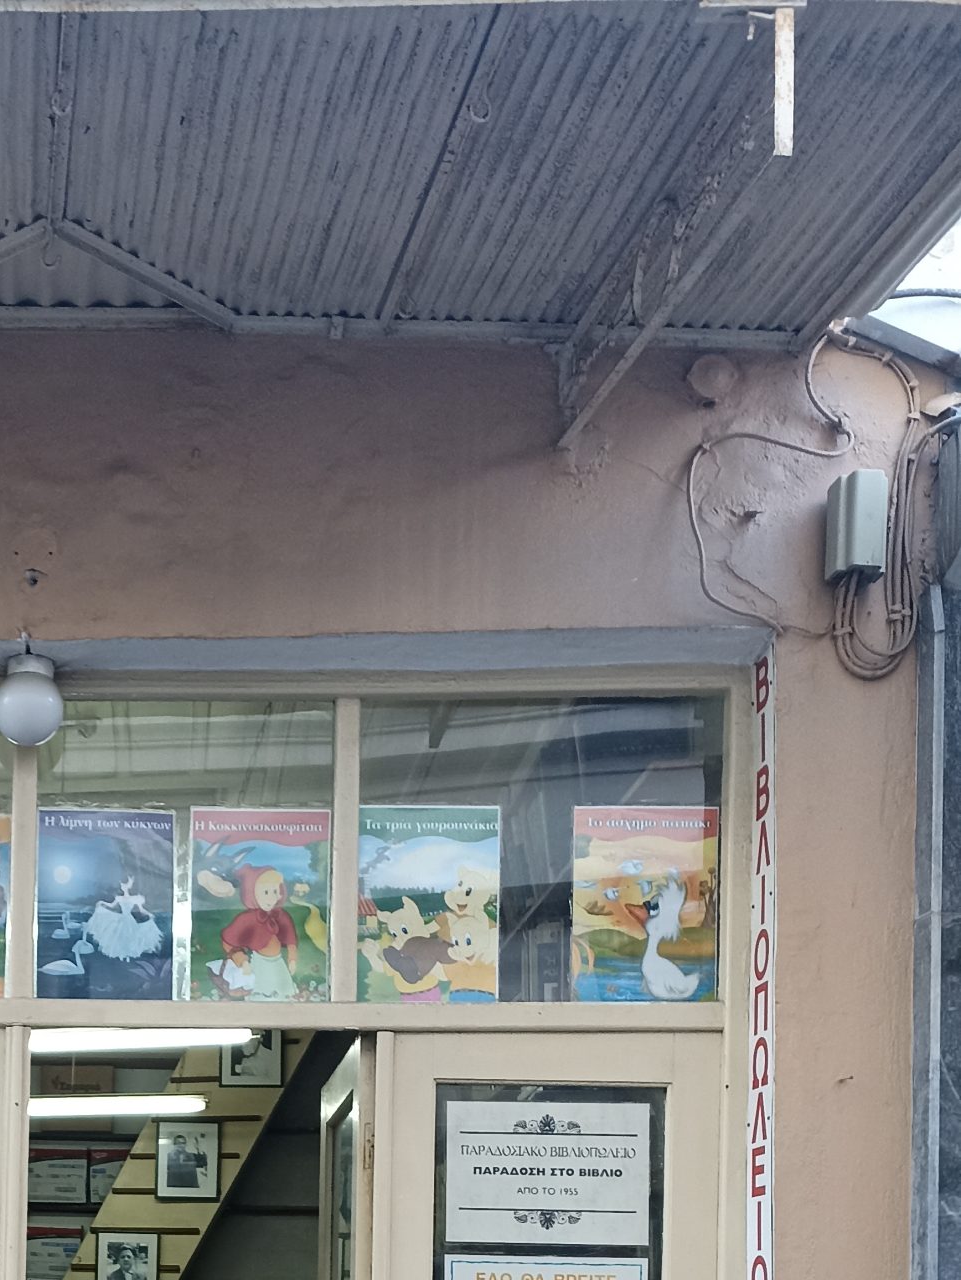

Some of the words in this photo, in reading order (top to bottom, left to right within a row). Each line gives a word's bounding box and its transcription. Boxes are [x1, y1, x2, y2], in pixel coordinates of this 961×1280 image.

[45, 816, 55, 826] Η
[59, 815, 92, 830] λίμνη
[97, 820, 121, 828] των
[124, 818, 172, 830] κύκνων
[195, 820, 205, 831] Η
[365, 819, 381, 830] Τα
[385, 818, 411, 833] τρία
[461, 1145, 547, 1158] ΠΑΡΑΔΟΣΙΑΚΟ
[550, 1146, 636, 1159] ΒΙΒΛΙΟΠΩΛΕΙΟ
[473, 1166, 546, 1176] ΠΑΡΑΔΟΣΗ
[550, 1168, 575, 1177] ΣΤΟ
[579, 1168, 623, 1178] ΒΙΒΛΙΟ
[516, 1187, 539, 1195] ΑΠΟ
[542, 1187, 556, 1195] ΤΟ
[560, 1187, 579, 1196] 1955
